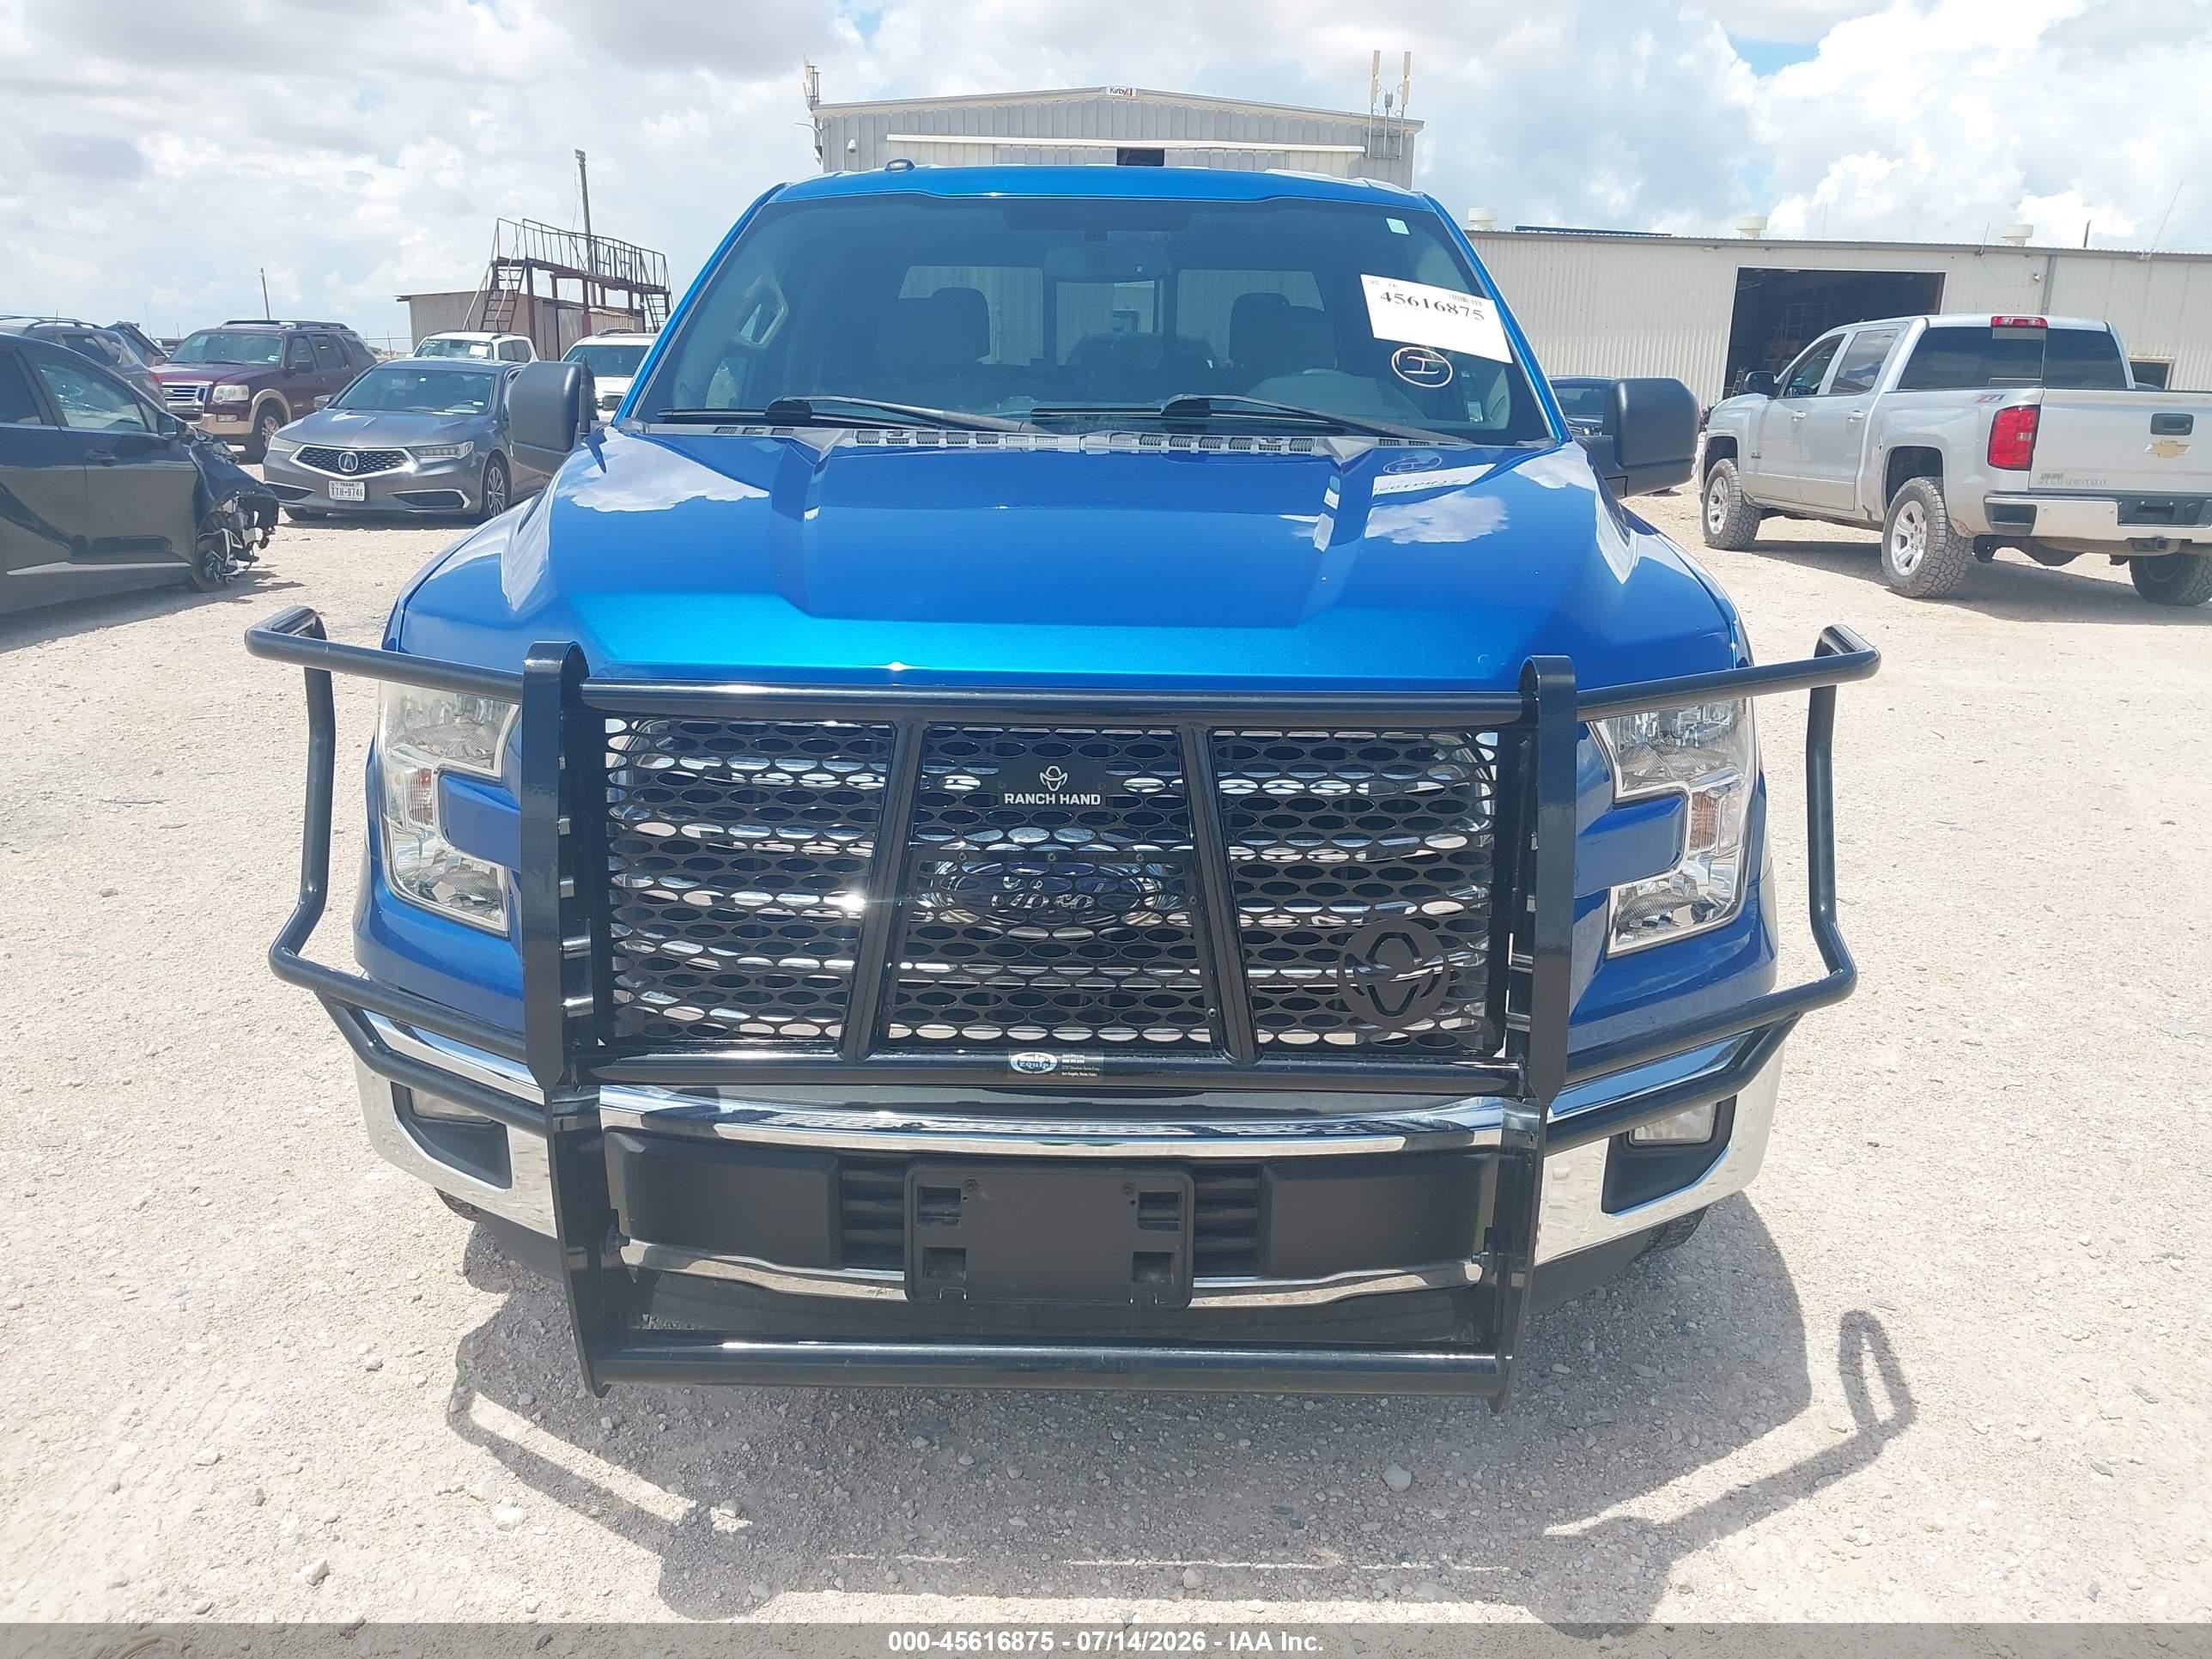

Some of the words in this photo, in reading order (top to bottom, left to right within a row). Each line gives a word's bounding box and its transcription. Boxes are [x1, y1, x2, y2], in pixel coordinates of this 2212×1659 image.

[1109, 87, 1127, 96] Kirby
[1380, 291, 1485, 321] 45616875
[1004, 793, 1055, 805] RANCH
[1060, 793, 1101, 805] HAND
